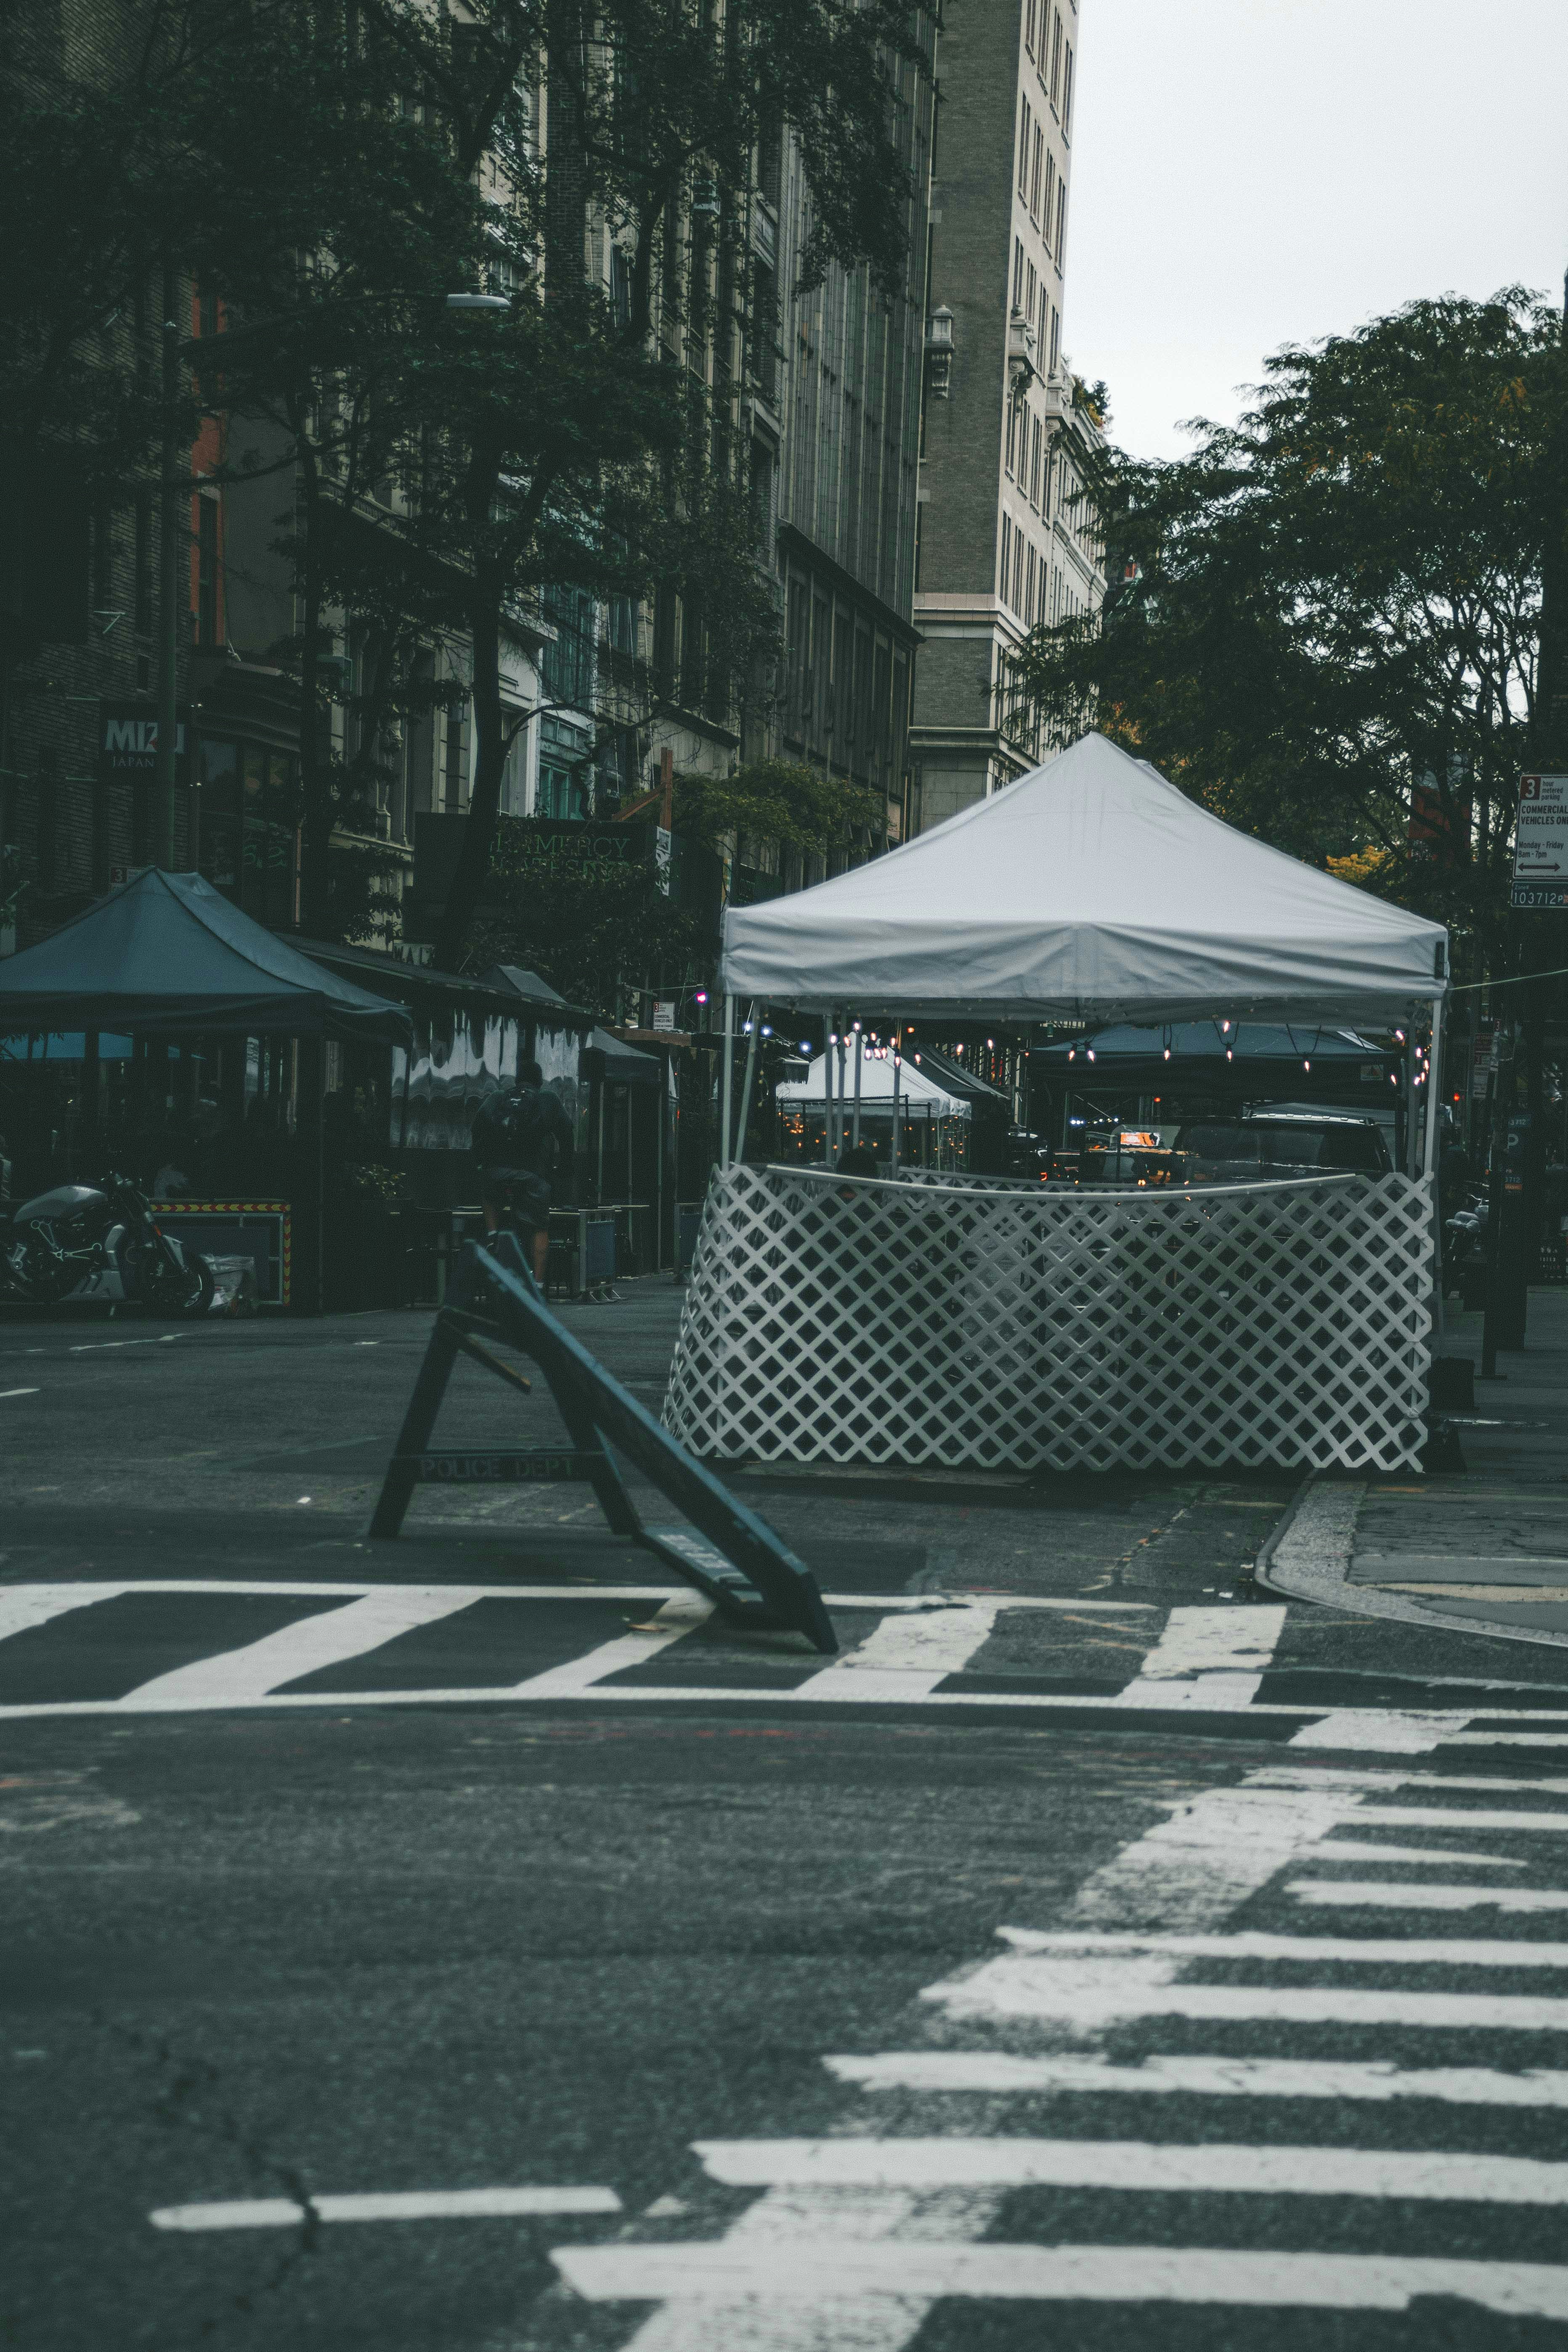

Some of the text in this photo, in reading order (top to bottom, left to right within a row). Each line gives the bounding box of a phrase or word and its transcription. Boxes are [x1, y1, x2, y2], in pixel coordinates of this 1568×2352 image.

[112, 756, 154, 767] JAPAN
[1525, 779, 1535, 798] 3
[1521, 805, 1568, 814] COMMERCIAL
[1521, 816, 1555, 825] VEHICLES
[1519, 841, 1541, 849] Monday
[1546, 841, 1564, 850] Friday
[114, 868, 122, 882] 3
[422, 1457, 499, 1478] POLICE
